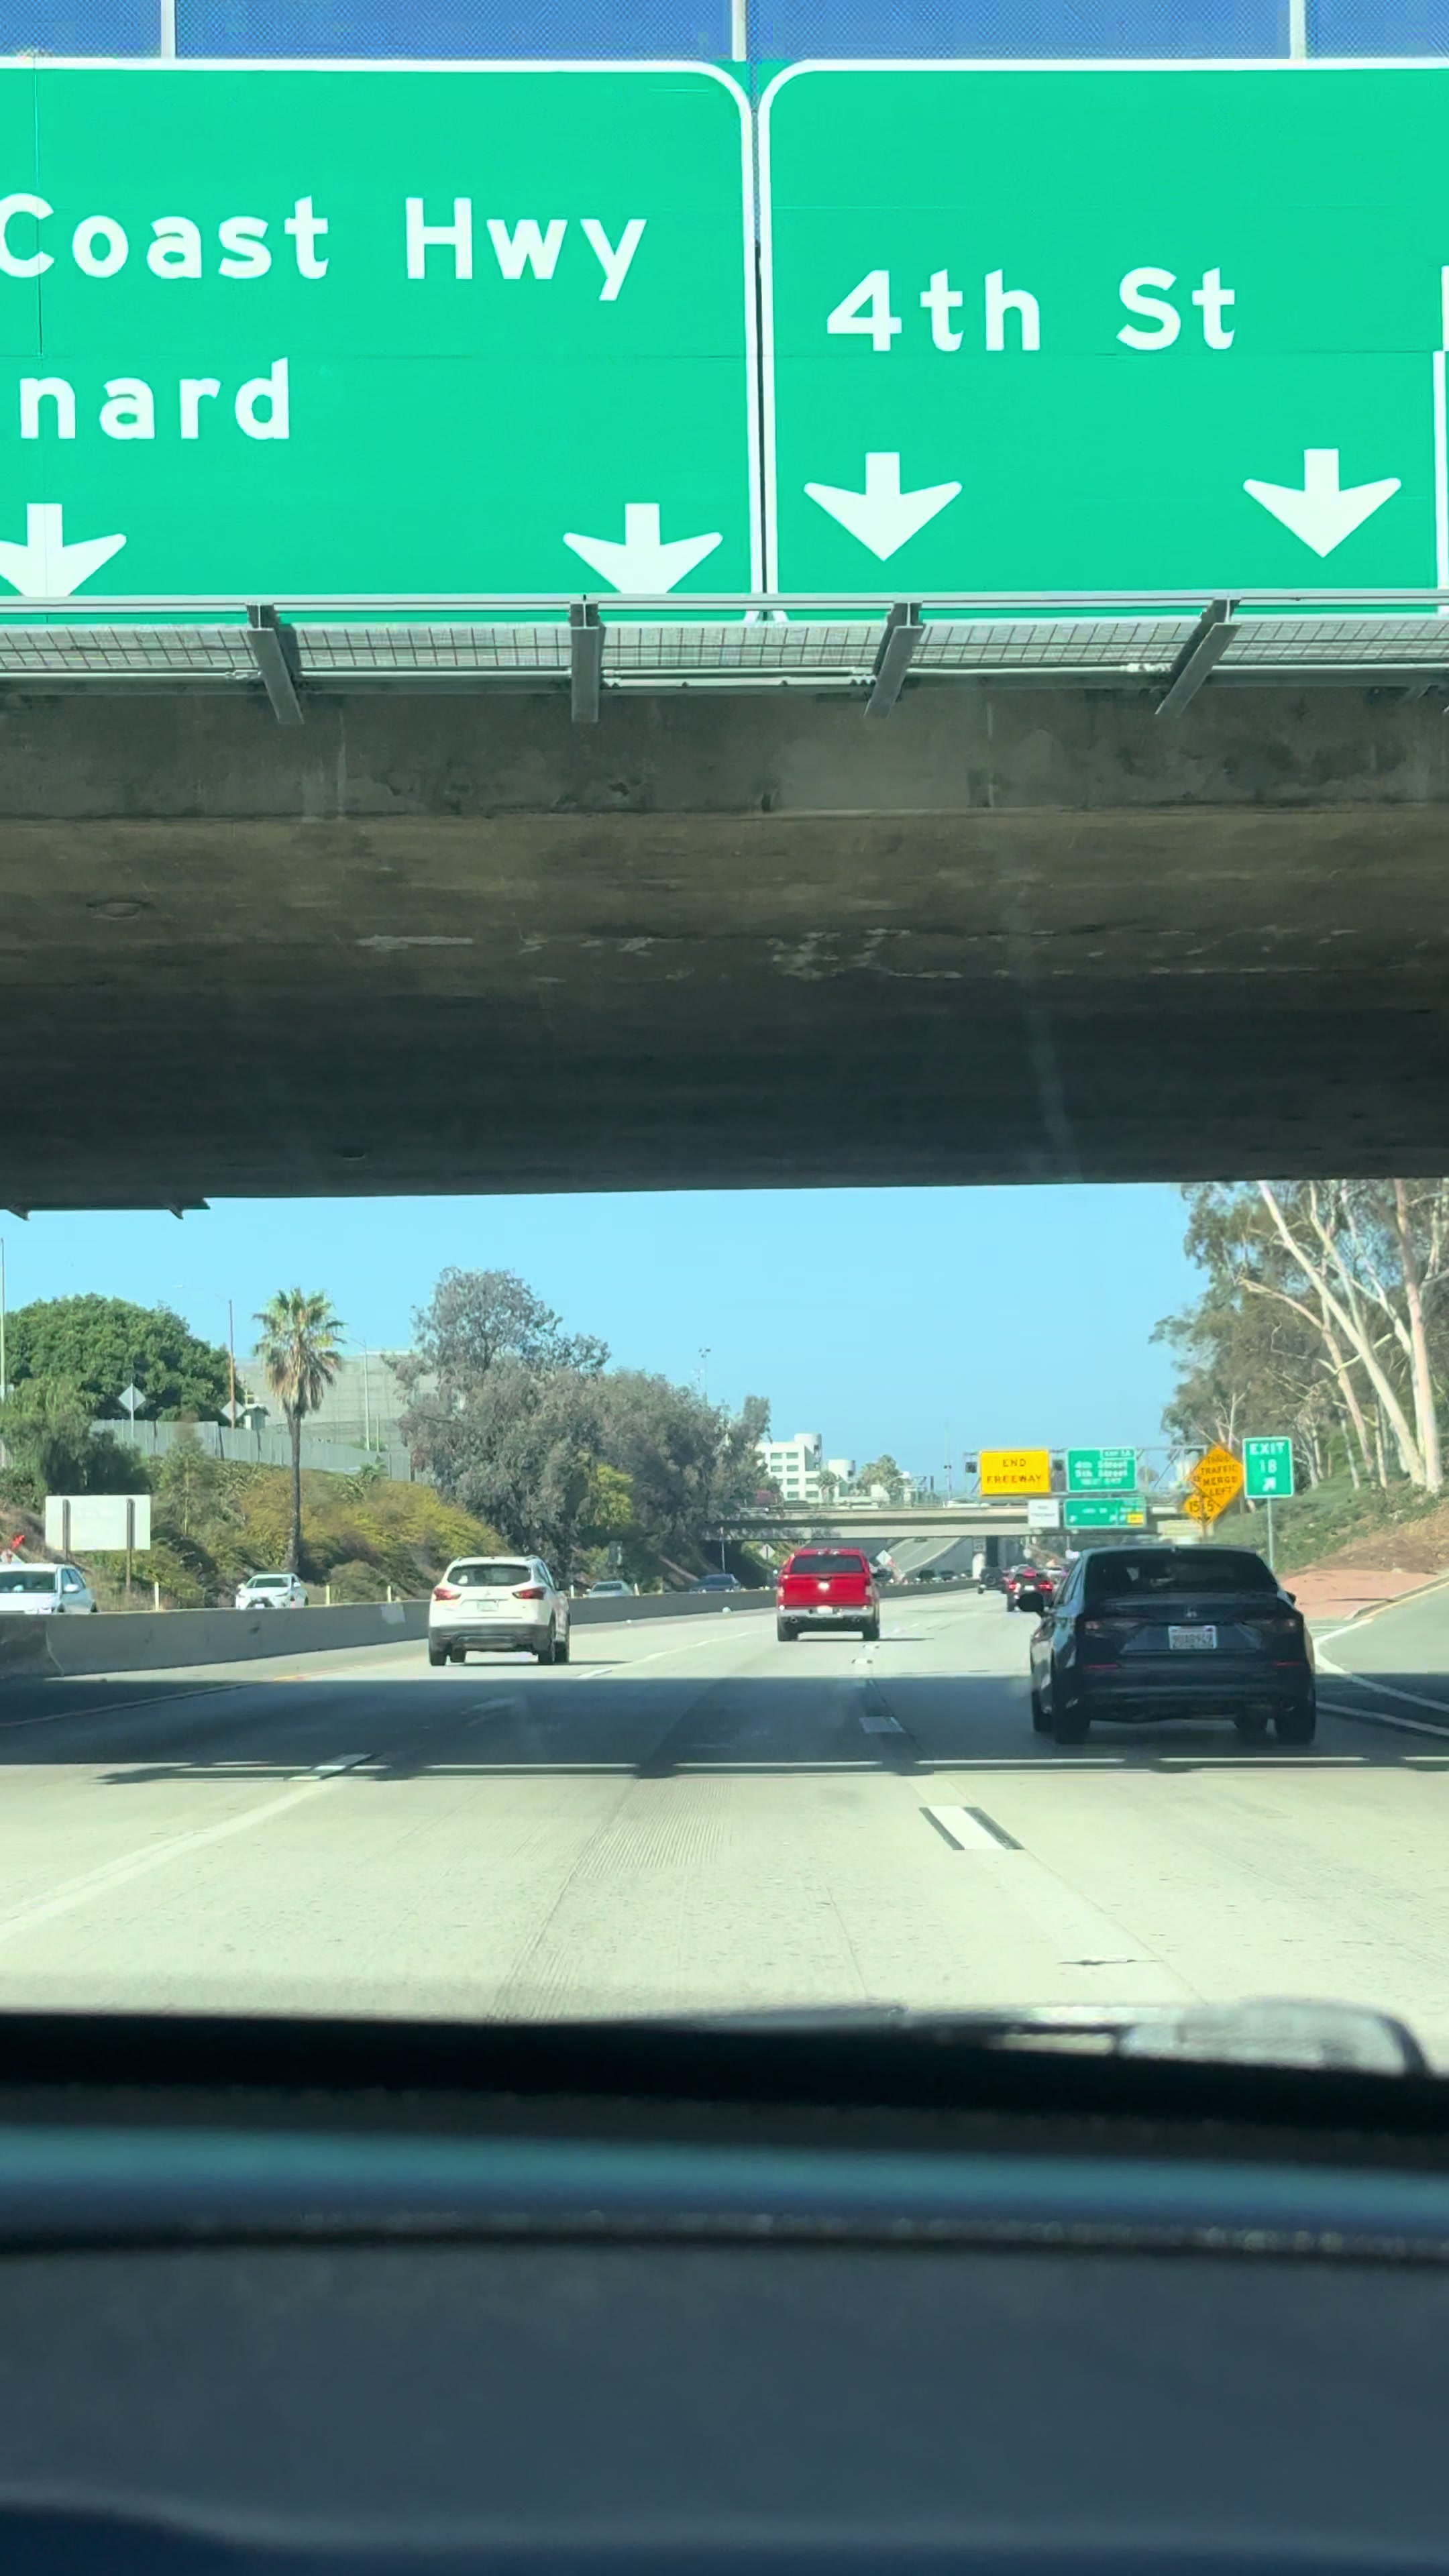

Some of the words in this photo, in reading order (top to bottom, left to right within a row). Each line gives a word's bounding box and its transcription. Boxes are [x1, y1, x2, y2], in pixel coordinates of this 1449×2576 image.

[0, 194, 327, 278] Coast
[407, 198, 645, 301] Hwy
[828, 270, 1039, 351] 4th
[1118, 268, 1234, 350] St
[21, 358, 288, 439] nard
[1249, 1442, 1285, 1455] EXIT
[1002, 1458, 1027, 1468] END
[1201, 1464, 1237, 1475] TRAFFIC
[986, 1474, 1042, 1485] FREEWAY
[1203, 1475, 1238, 1486] MERGE
[1210, 1486, 1232, 1496] LEFT
